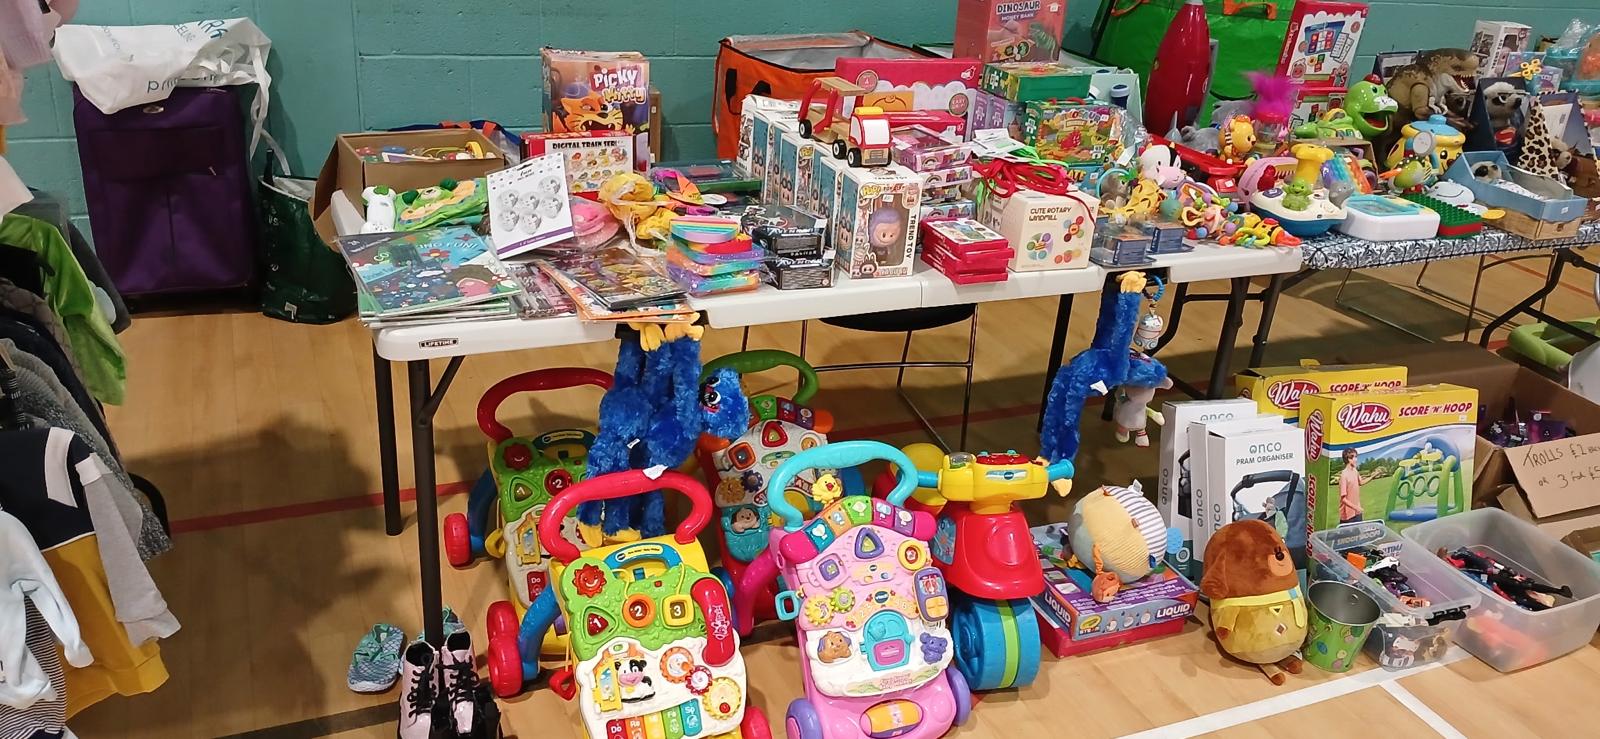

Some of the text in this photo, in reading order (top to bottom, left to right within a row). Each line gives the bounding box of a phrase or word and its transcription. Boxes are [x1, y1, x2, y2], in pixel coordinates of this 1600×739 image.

[997, 1, 1040, 13] DINOSAUR
[552, 141, 580, 149] DIGITAL
[906, 214, 917, 258] TREND TOY
[1330, 384, 1361, 393] SCORE
[1338, 402, 1391, 428] Wahu
[1398, 405, 1429, 417] SCORE
[1443, 402, 1473, 413] HOOP
[1236, 453, 1294, 465] PRAM ORGANISER
[1523, 445, 1564, 468] TROLLS
[555, 478, 563, 489] 2
[1557, 473, 1569, 489] 3
[1307, 474, 1316, 509] SCORE
[1213, 503, 1221, 531] nco
[634, 606, 643, 617] 2
[674, 605, 682, 616] 3
[1044, 591, 1071, 623] LIQUID
[1157, 603, 1190, 617] LIQUID
[593, 617, 602, 629] 1
[611, 725, 622, 734] Do
